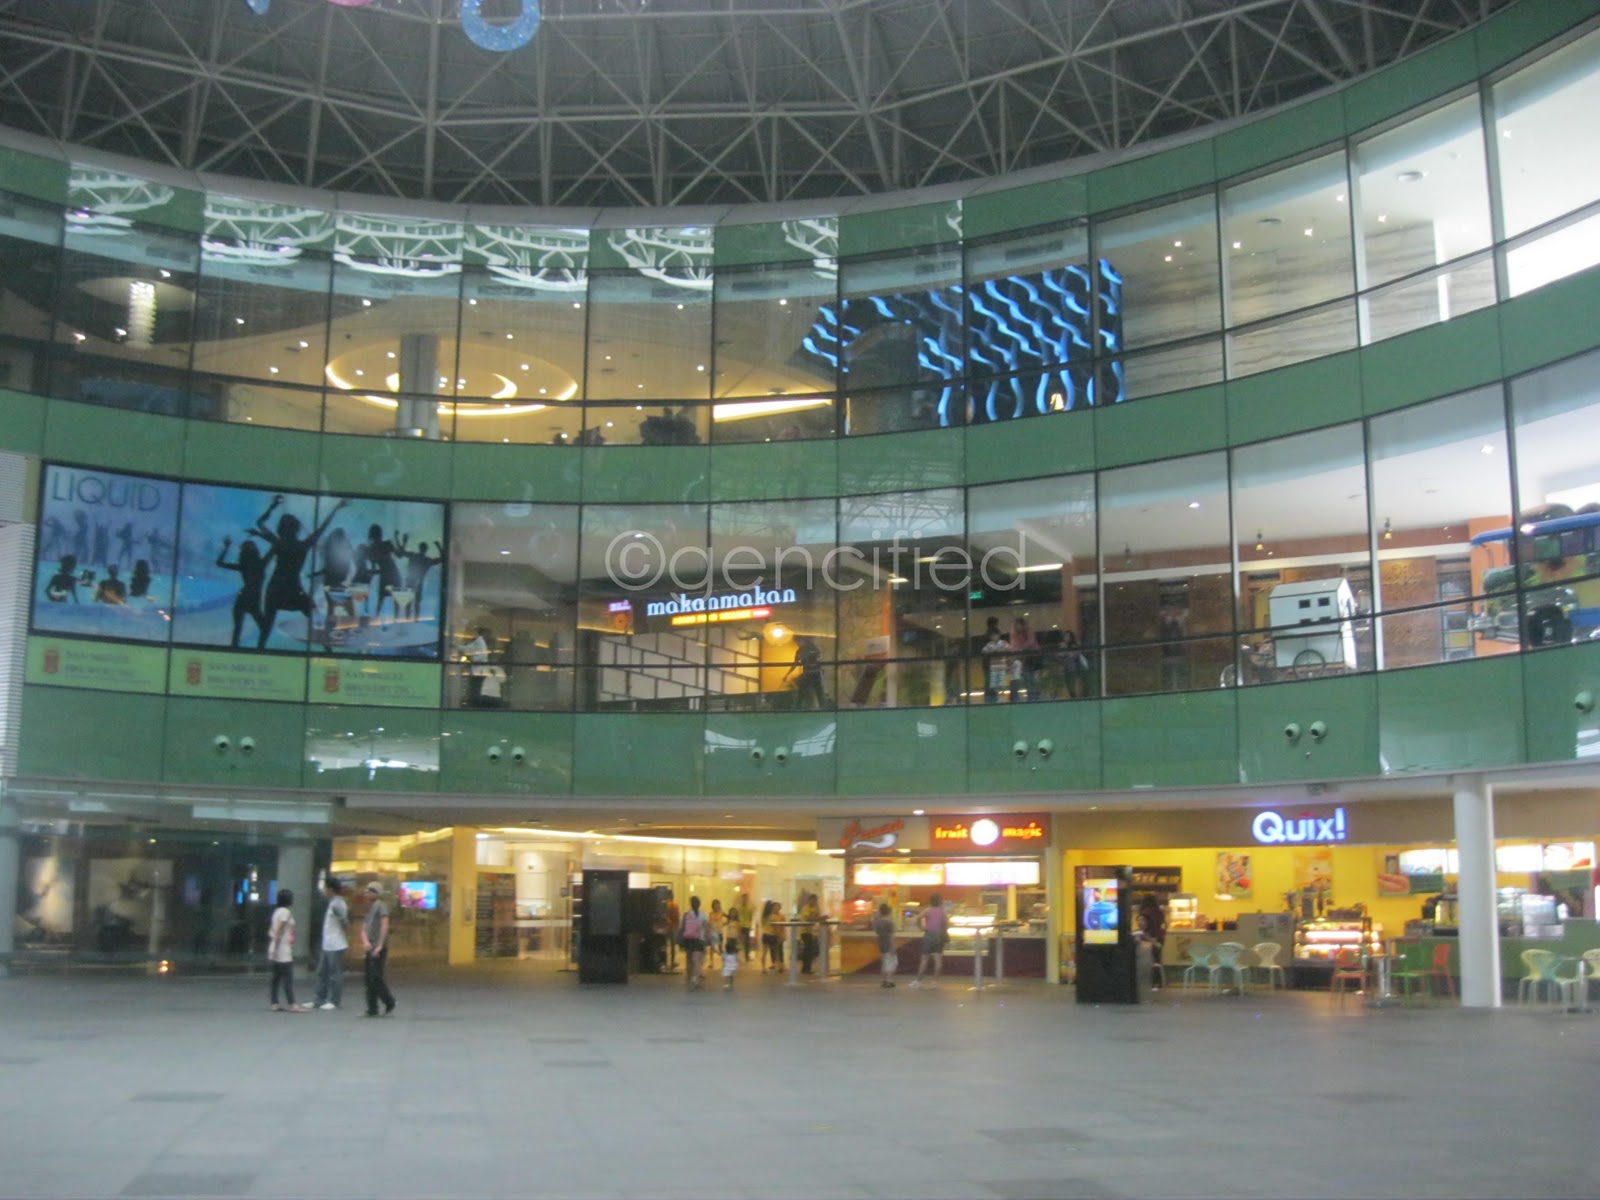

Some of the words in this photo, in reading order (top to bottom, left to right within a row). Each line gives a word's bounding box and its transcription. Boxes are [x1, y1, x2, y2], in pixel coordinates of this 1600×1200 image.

[53, 472, 161, 511] LIQUID
[935, 823, 969, 839] fruit
[1002, 822, 1042, 840] magic
